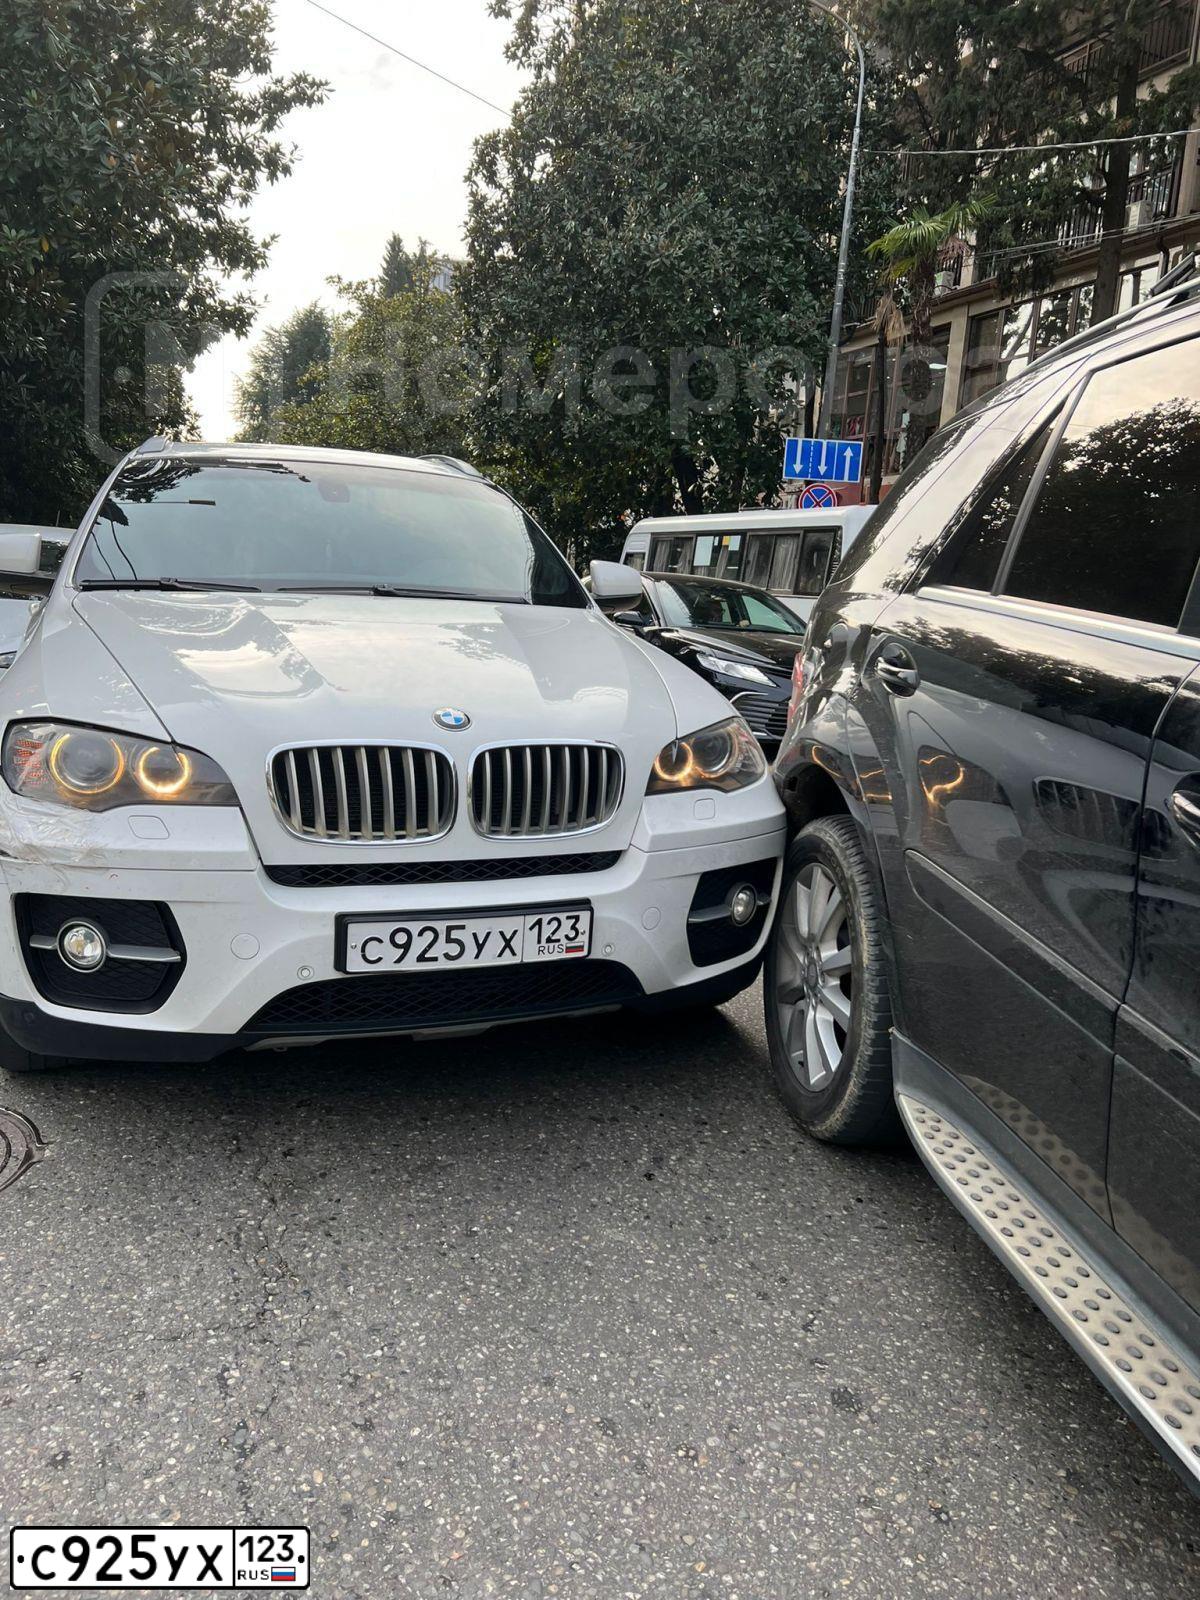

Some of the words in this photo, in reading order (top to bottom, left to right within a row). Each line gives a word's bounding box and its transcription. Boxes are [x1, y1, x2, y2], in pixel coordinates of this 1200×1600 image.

[360, 924, 519, 965] С925УХ
[528, 914, 581, 945] 123
[537, 943, 564, 956] RUS
